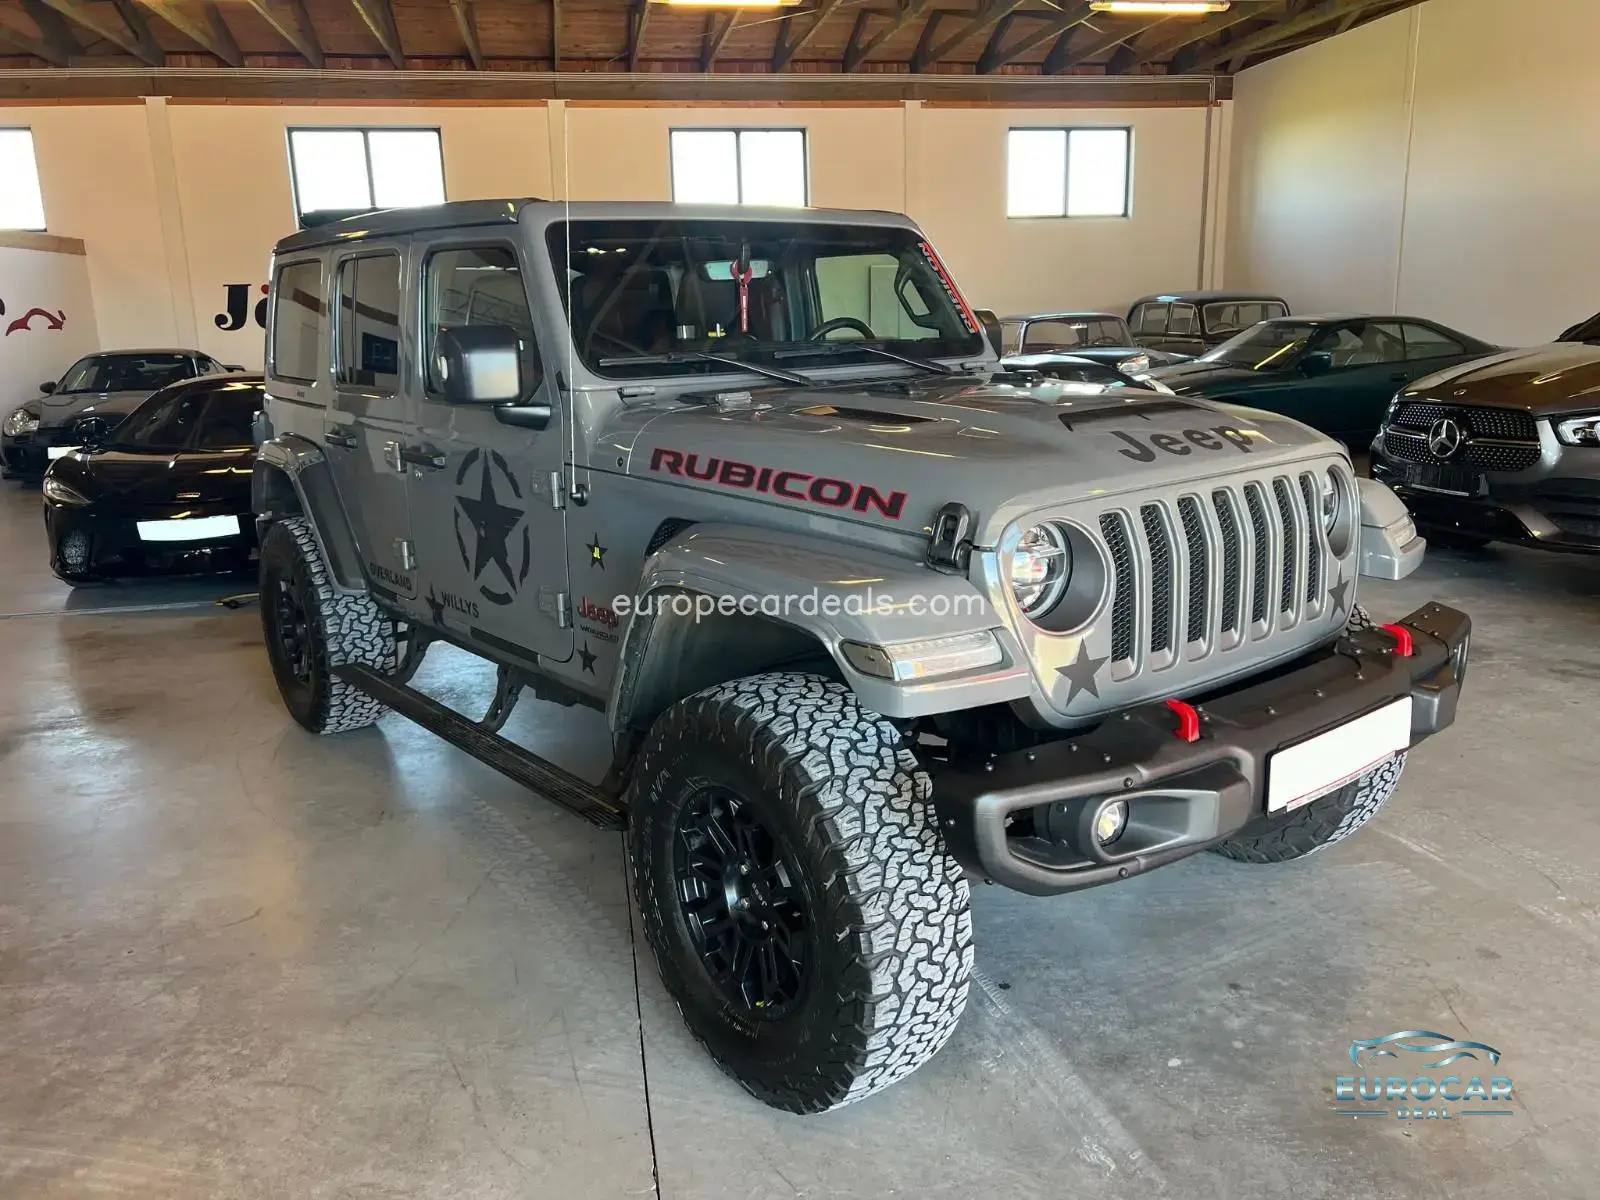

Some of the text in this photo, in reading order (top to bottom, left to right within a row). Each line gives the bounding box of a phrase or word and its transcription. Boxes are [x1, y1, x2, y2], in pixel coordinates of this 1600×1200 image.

[917, 242, 976, 334] RUBICON
[1109, 425, 1255, 463] Jeep
[650, 448, 908, 521] RUBICON
[369, 562, 412, 592] OVERLAND
[441, 591, 480, 618] WILLYS
[577, 595, 619, 629] Jeep
